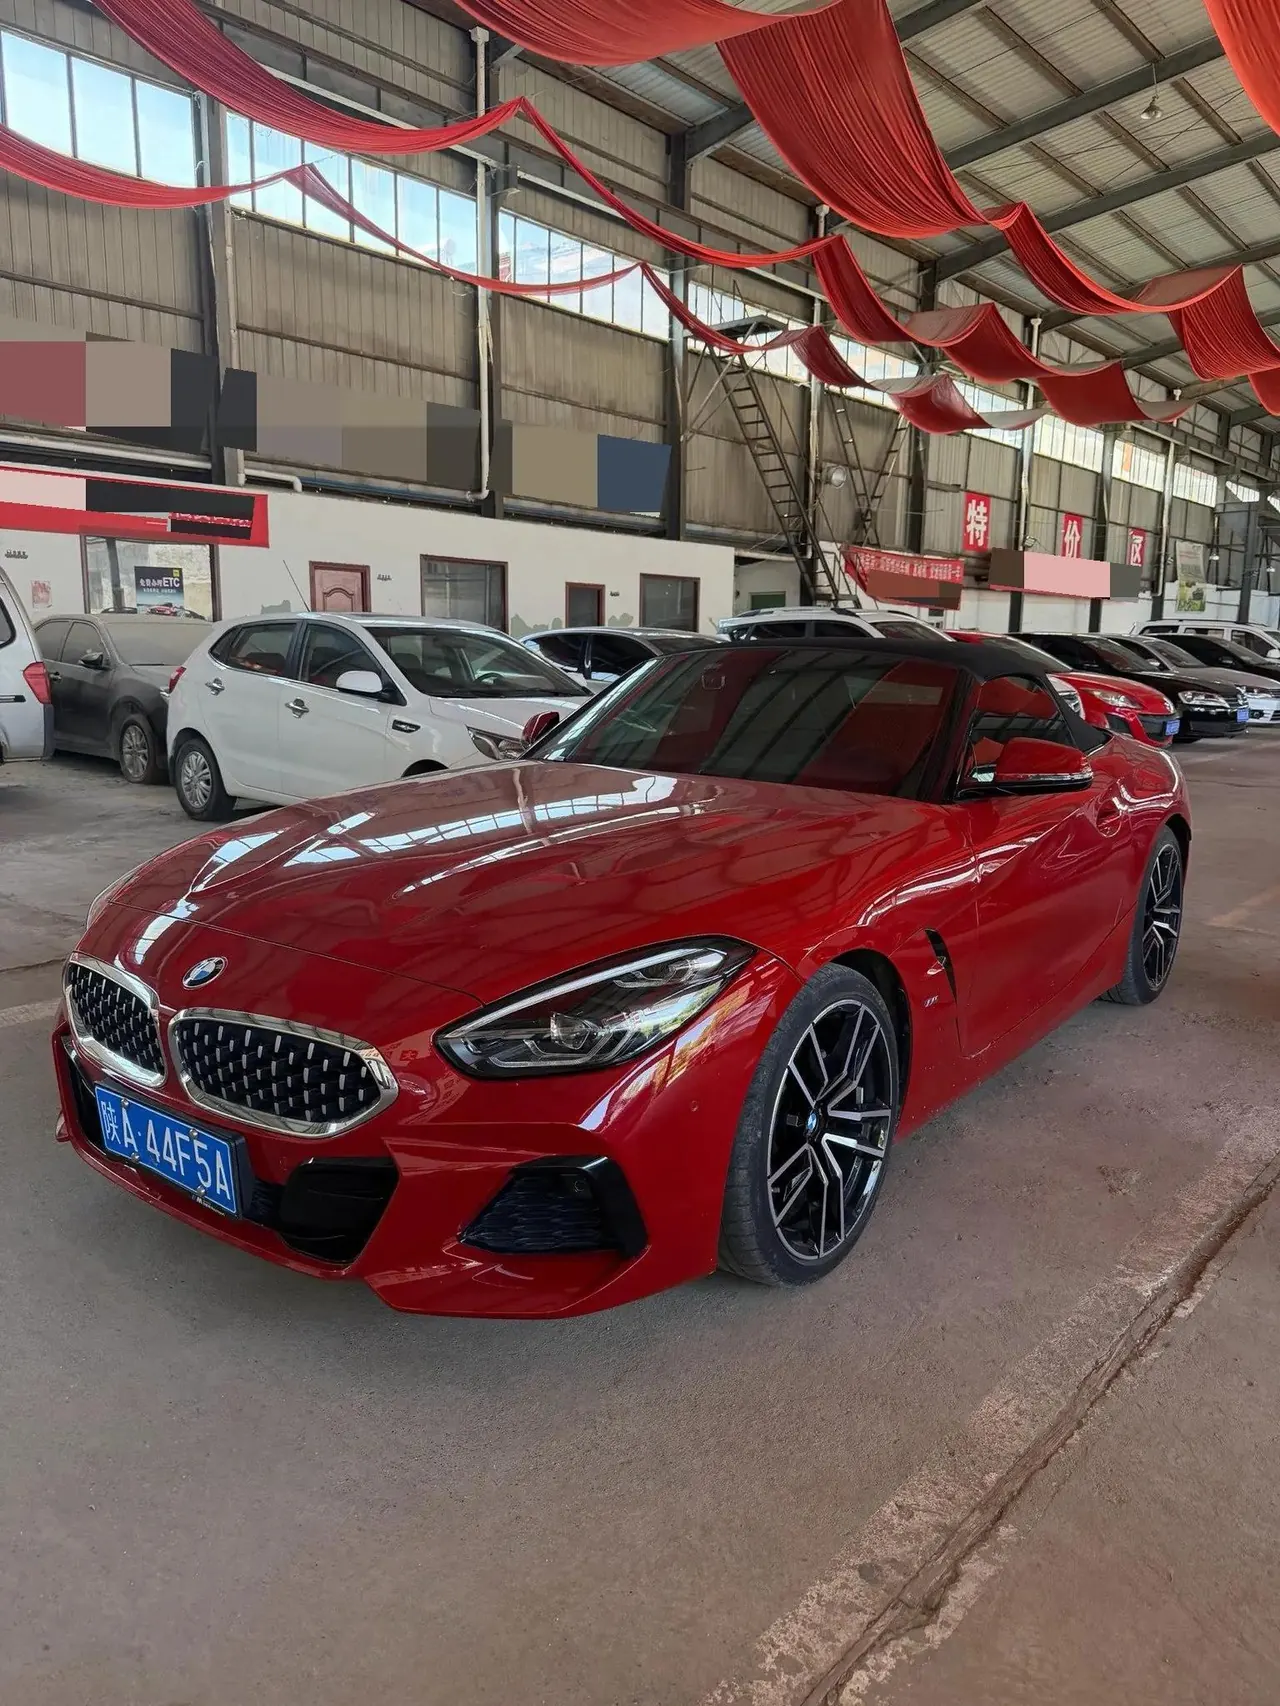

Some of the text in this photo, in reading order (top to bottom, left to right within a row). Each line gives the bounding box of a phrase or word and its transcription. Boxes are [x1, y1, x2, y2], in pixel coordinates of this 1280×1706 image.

[966, 499, 988, 546] 特
[1064, 520, 1081, 558] 价
[1129, 535, 1143, 567] 区
